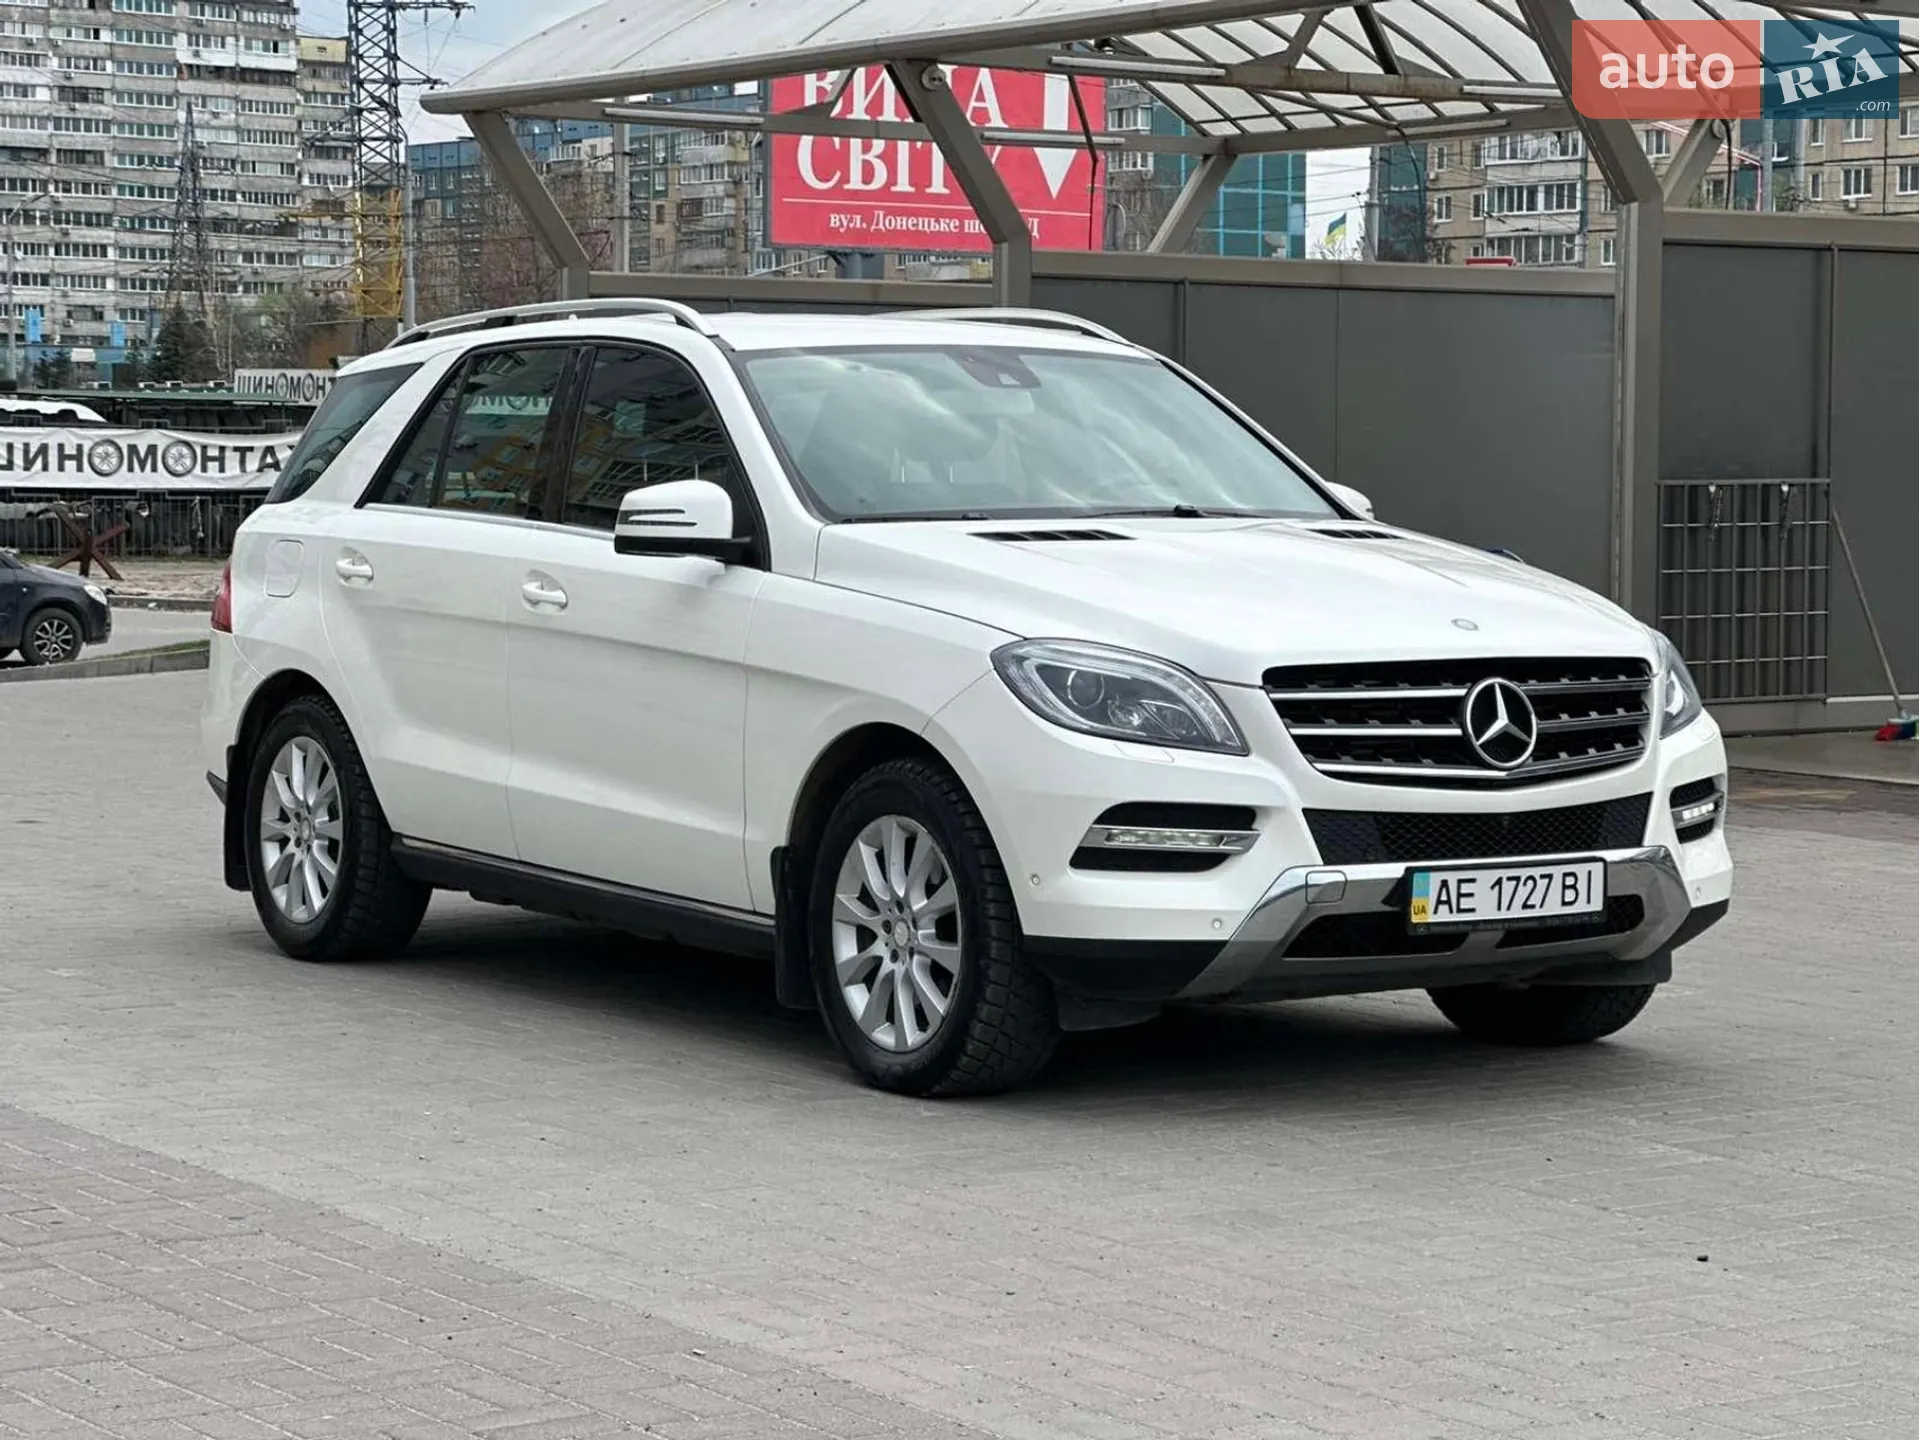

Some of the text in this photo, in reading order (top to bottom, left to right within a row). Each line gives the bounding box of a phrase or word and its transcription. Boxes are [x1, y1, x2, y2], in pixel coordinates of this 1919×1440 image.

[803, 64, 1009, 128] ВИА
[797, 134, 1002, 194] СВІТ
[829, 213, 867, 232] вул.
[871, 210, 960, 234] Донецьке
[0, 438, 296, 478] ИНОМОНТА
[1413, 904, 1427, 916] UA
[1433, 869, 1593, 915] AE 1727 BI
